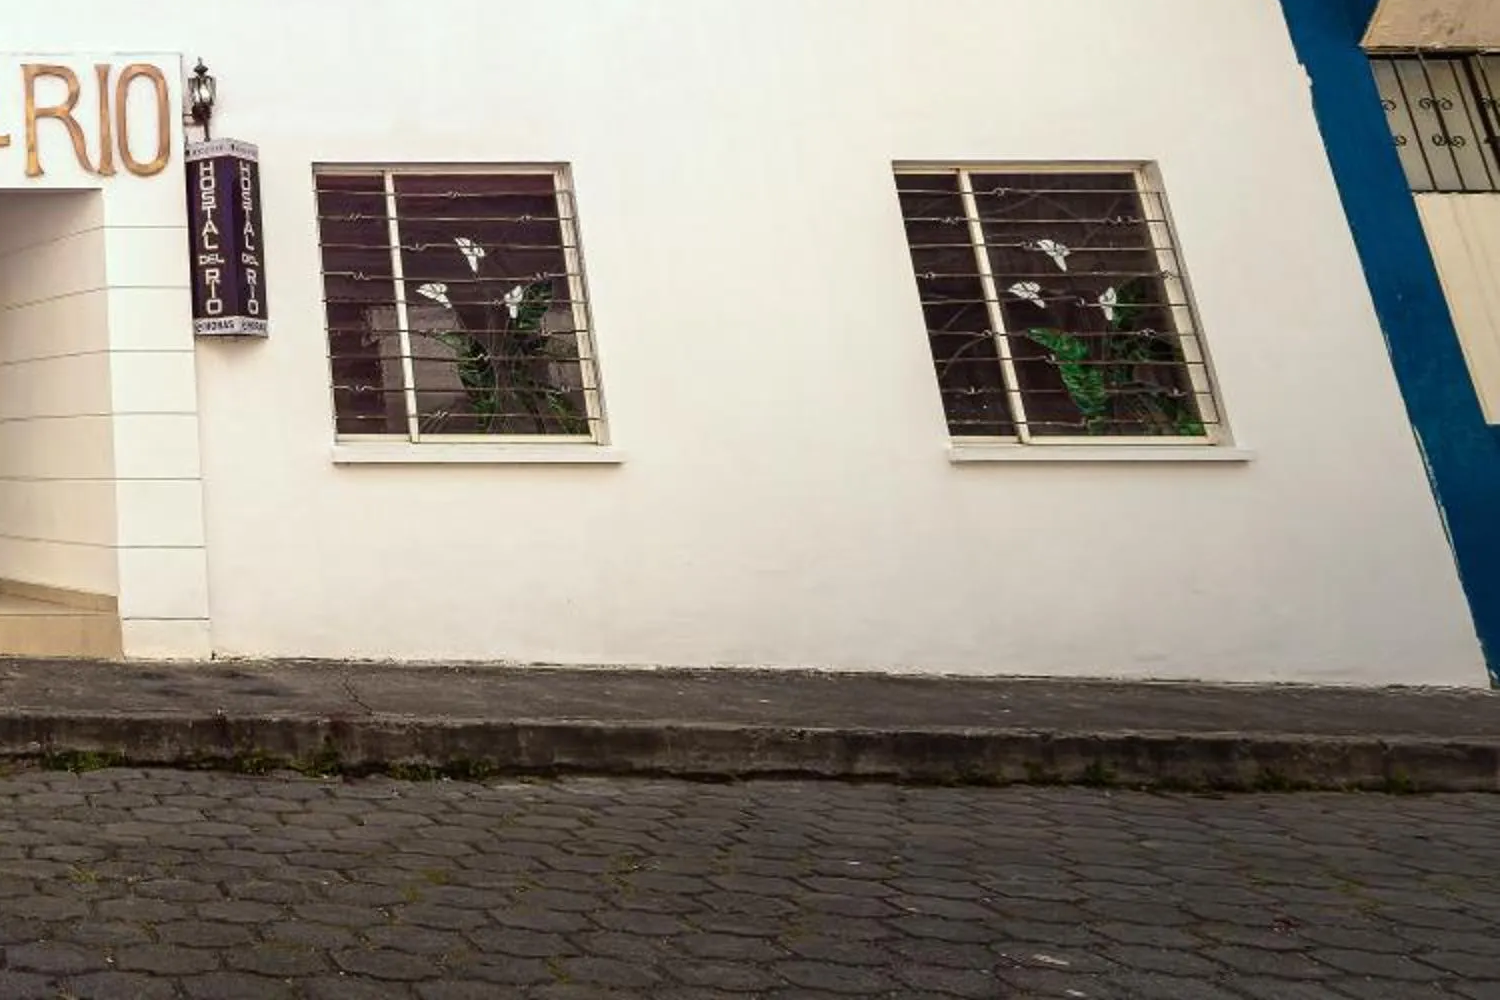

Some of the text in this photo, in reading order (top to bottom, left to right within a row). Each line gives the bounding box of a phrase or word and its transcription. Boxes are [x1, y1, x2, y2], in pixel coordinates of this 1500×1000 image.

[20, 63, 172, 177] RIO
[200, 161, 219, 250] HOSTAL
[239, 160, 255, 250] HOSTAL
[199, 254, 225, 265] DEL
[205, 268, 223, 315] RIO
[246, 268, 259, 315] RIO
